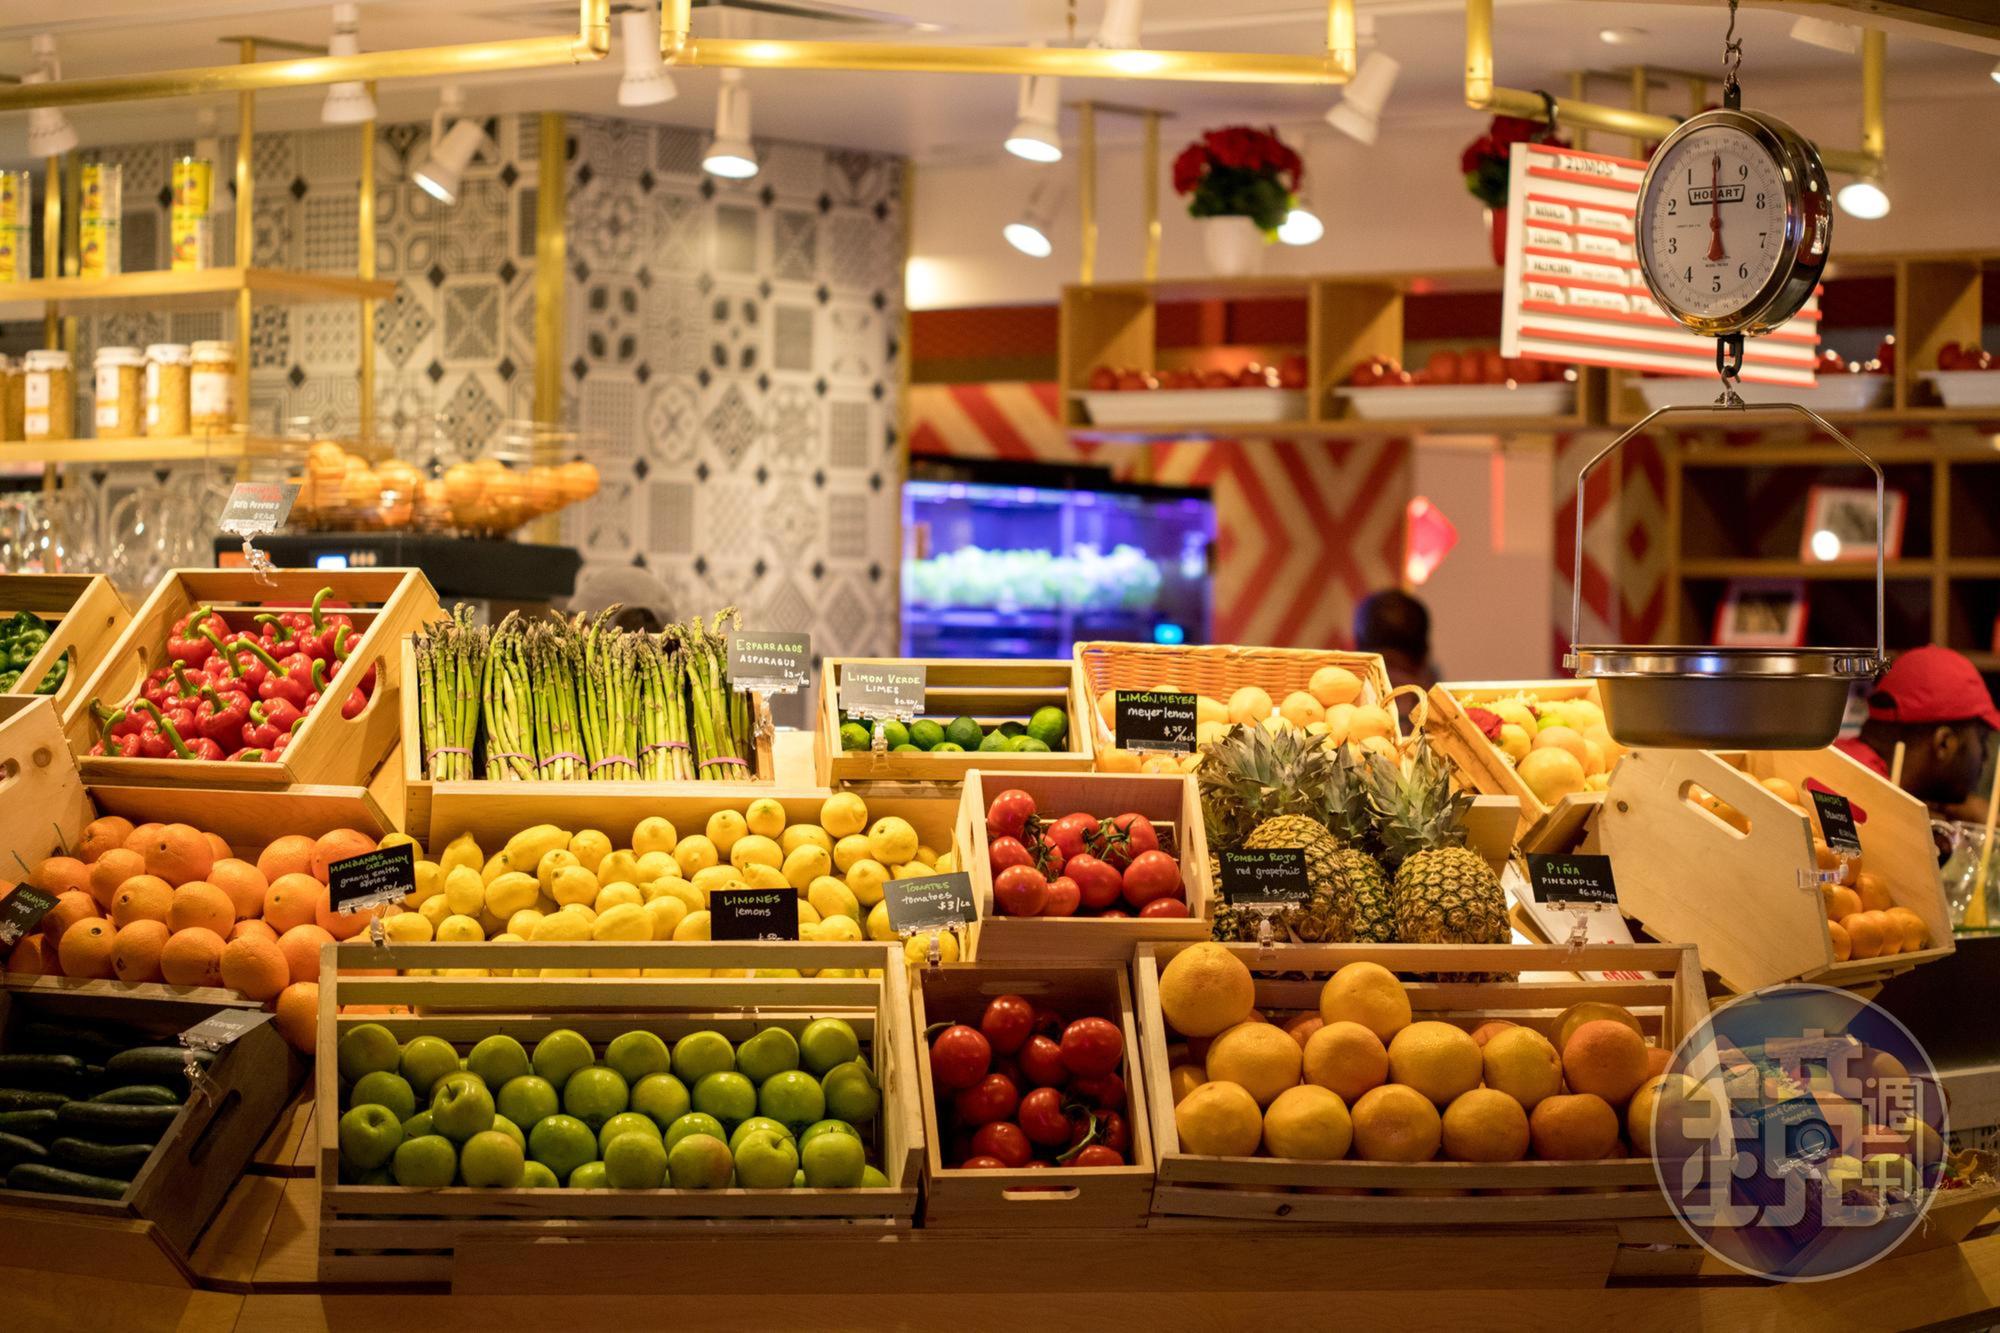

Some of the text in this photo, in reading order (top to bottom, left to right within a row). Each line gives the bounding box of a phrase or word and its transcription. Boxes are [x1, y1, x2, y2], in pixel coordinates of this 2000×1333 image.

[1687, 169, 1692, 185] 1
[1739, 165, 1748, 181] 9
[1668, 199, 1677, 216] 2
[1756, 193, 1766, 210] 8
[1668, 238, 1677, 254] 3
[1759, 232, 1767, 249] 7
[1684, 266, 1693, 283] 4
[1738, 263, 1748, 280] 6
[1712, 275, 1721, 293] 5
[736, 639, 803, 653] ESPARRAGOS
[739, 654, 796, 667] ASPARAGUS
[847, 672, 920, 684] LIMON VERDE
[865, 685, 899, 695] LIMES
[1160, 694, 1196, 705] MEYER
[1127, 706, 1195, 721] meyer lemon
[1226, 852, 1297, 864] POMELO ROJO
[1236, 861, 1300, 880] red grapefruit
[1546, 862, 1580, 875] PIÑA
[1541, 877, 1599, 886] PINEAPPLE
[723, 894, 781, 906] LIMONES
[901, 891, 953, 905] tomatoes
[735, 907, 772, 918] lemons
